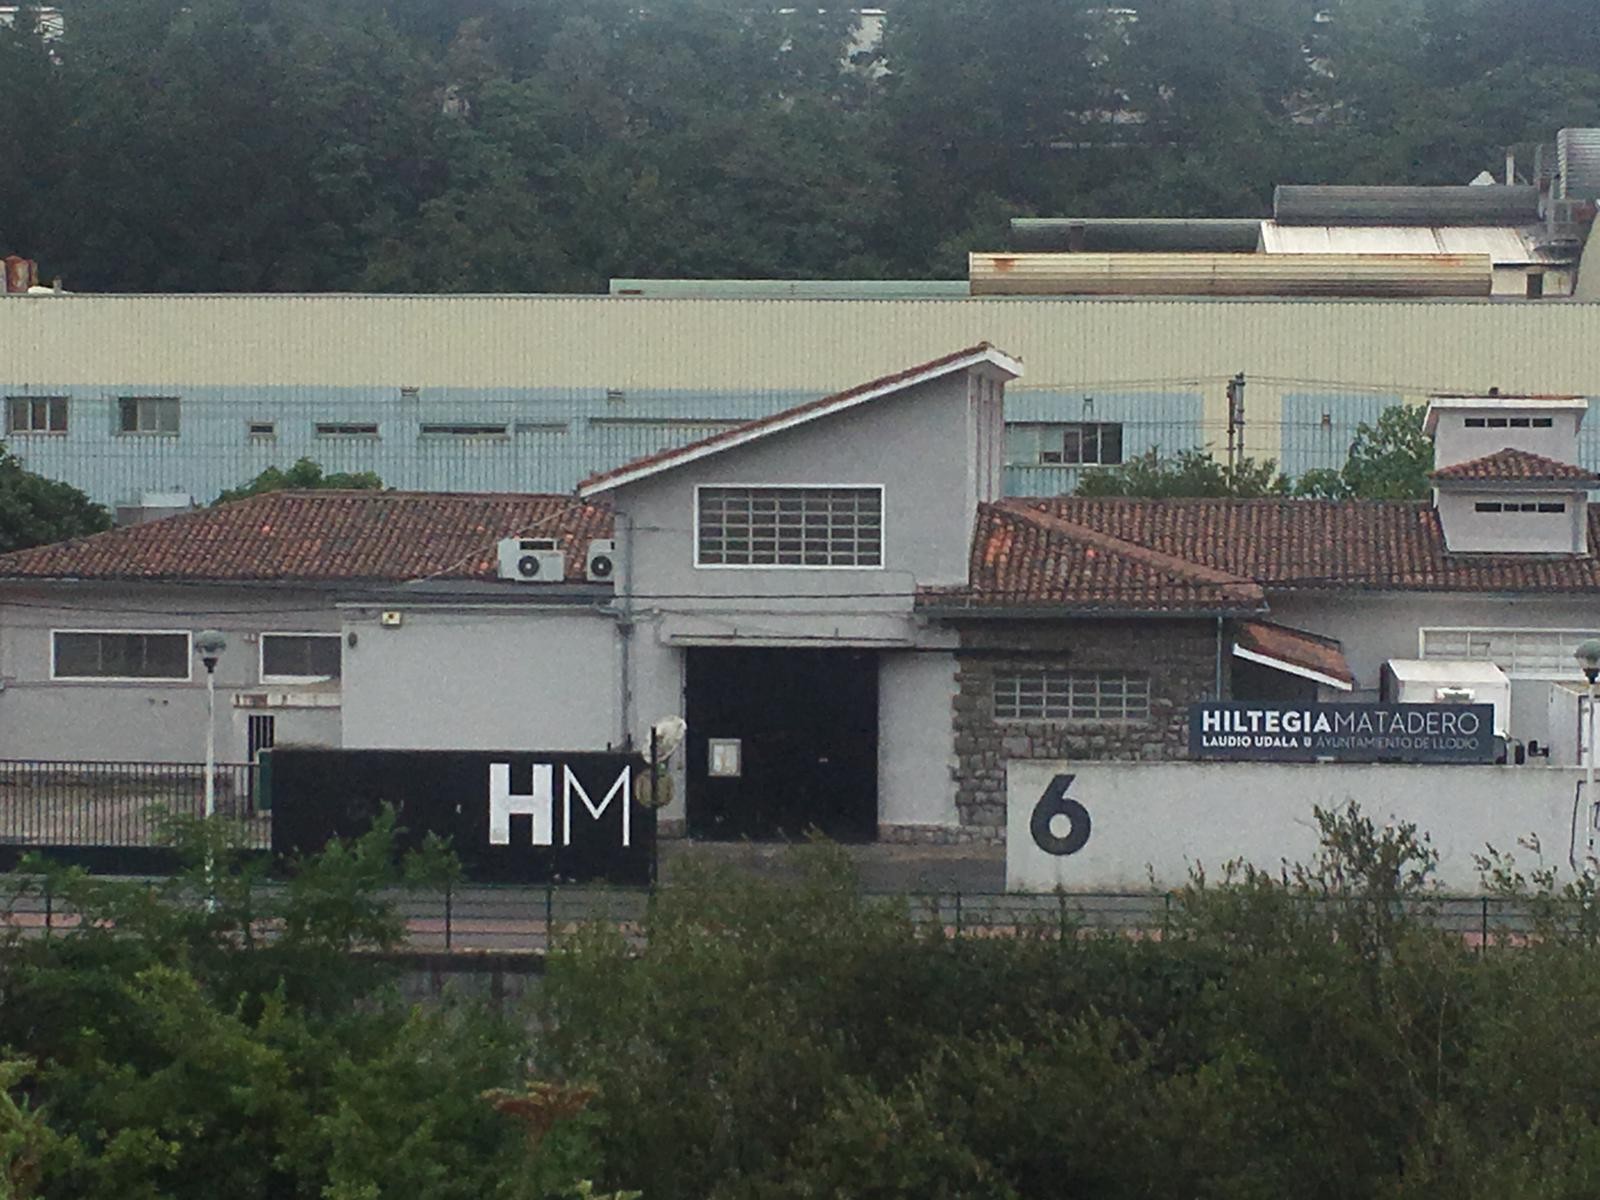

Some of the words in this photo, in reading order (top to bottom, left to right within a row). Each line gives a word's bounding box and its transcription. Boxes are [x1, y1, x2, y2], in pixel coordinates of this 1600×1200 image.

[1202, 735, 1251, 748] LAUDIO
[1254, 736, 1299, 749] UDALA
[1414, 737, 1430, 749] DE
[489, 762, 631, 847] HM
[1030, 773, 1092, 857] 6
